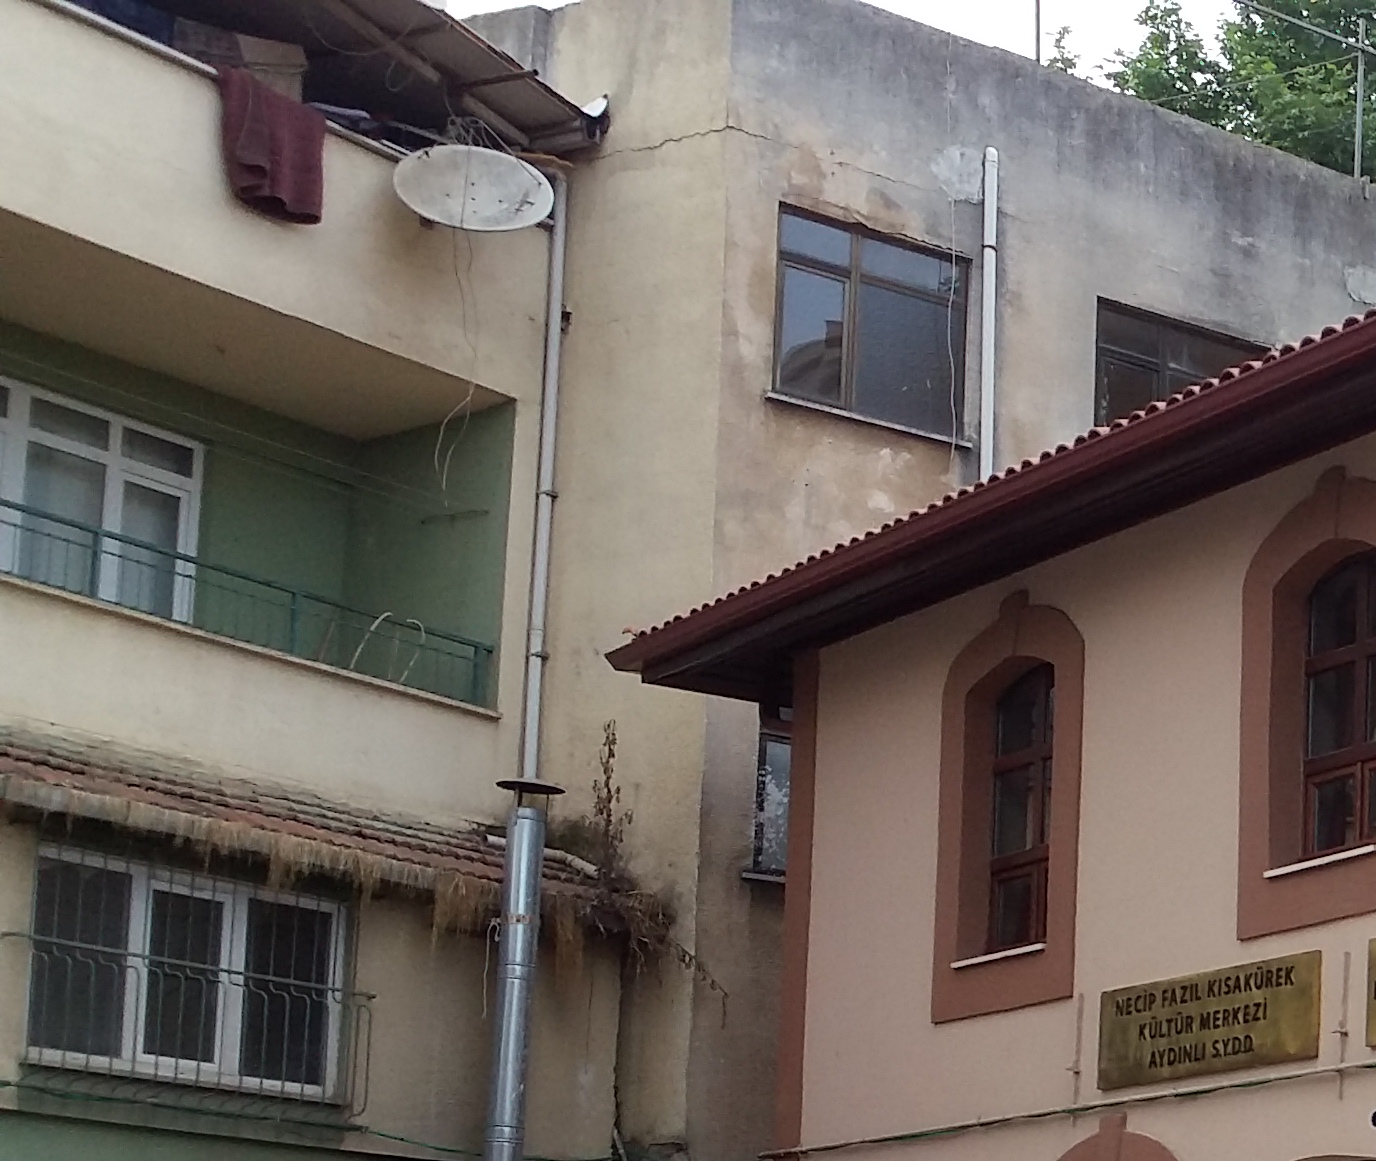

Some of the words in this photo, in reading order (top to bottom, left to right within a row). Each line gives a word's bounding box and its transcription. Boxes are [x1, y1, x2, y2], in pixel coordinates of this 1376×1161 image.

[1115, 989, 1157, 1017] NECİP
[1161, 982, 1202, 1008] FAZIL
[1206, 965, 1295, 998] KISAKÜREK
[1138, 1011, 1194, 1041] KÜLTÜR
[1199, 997, 1268, 1032] MERKEZİ
[1148, 1042, 1206, 1069] AYDINLI
